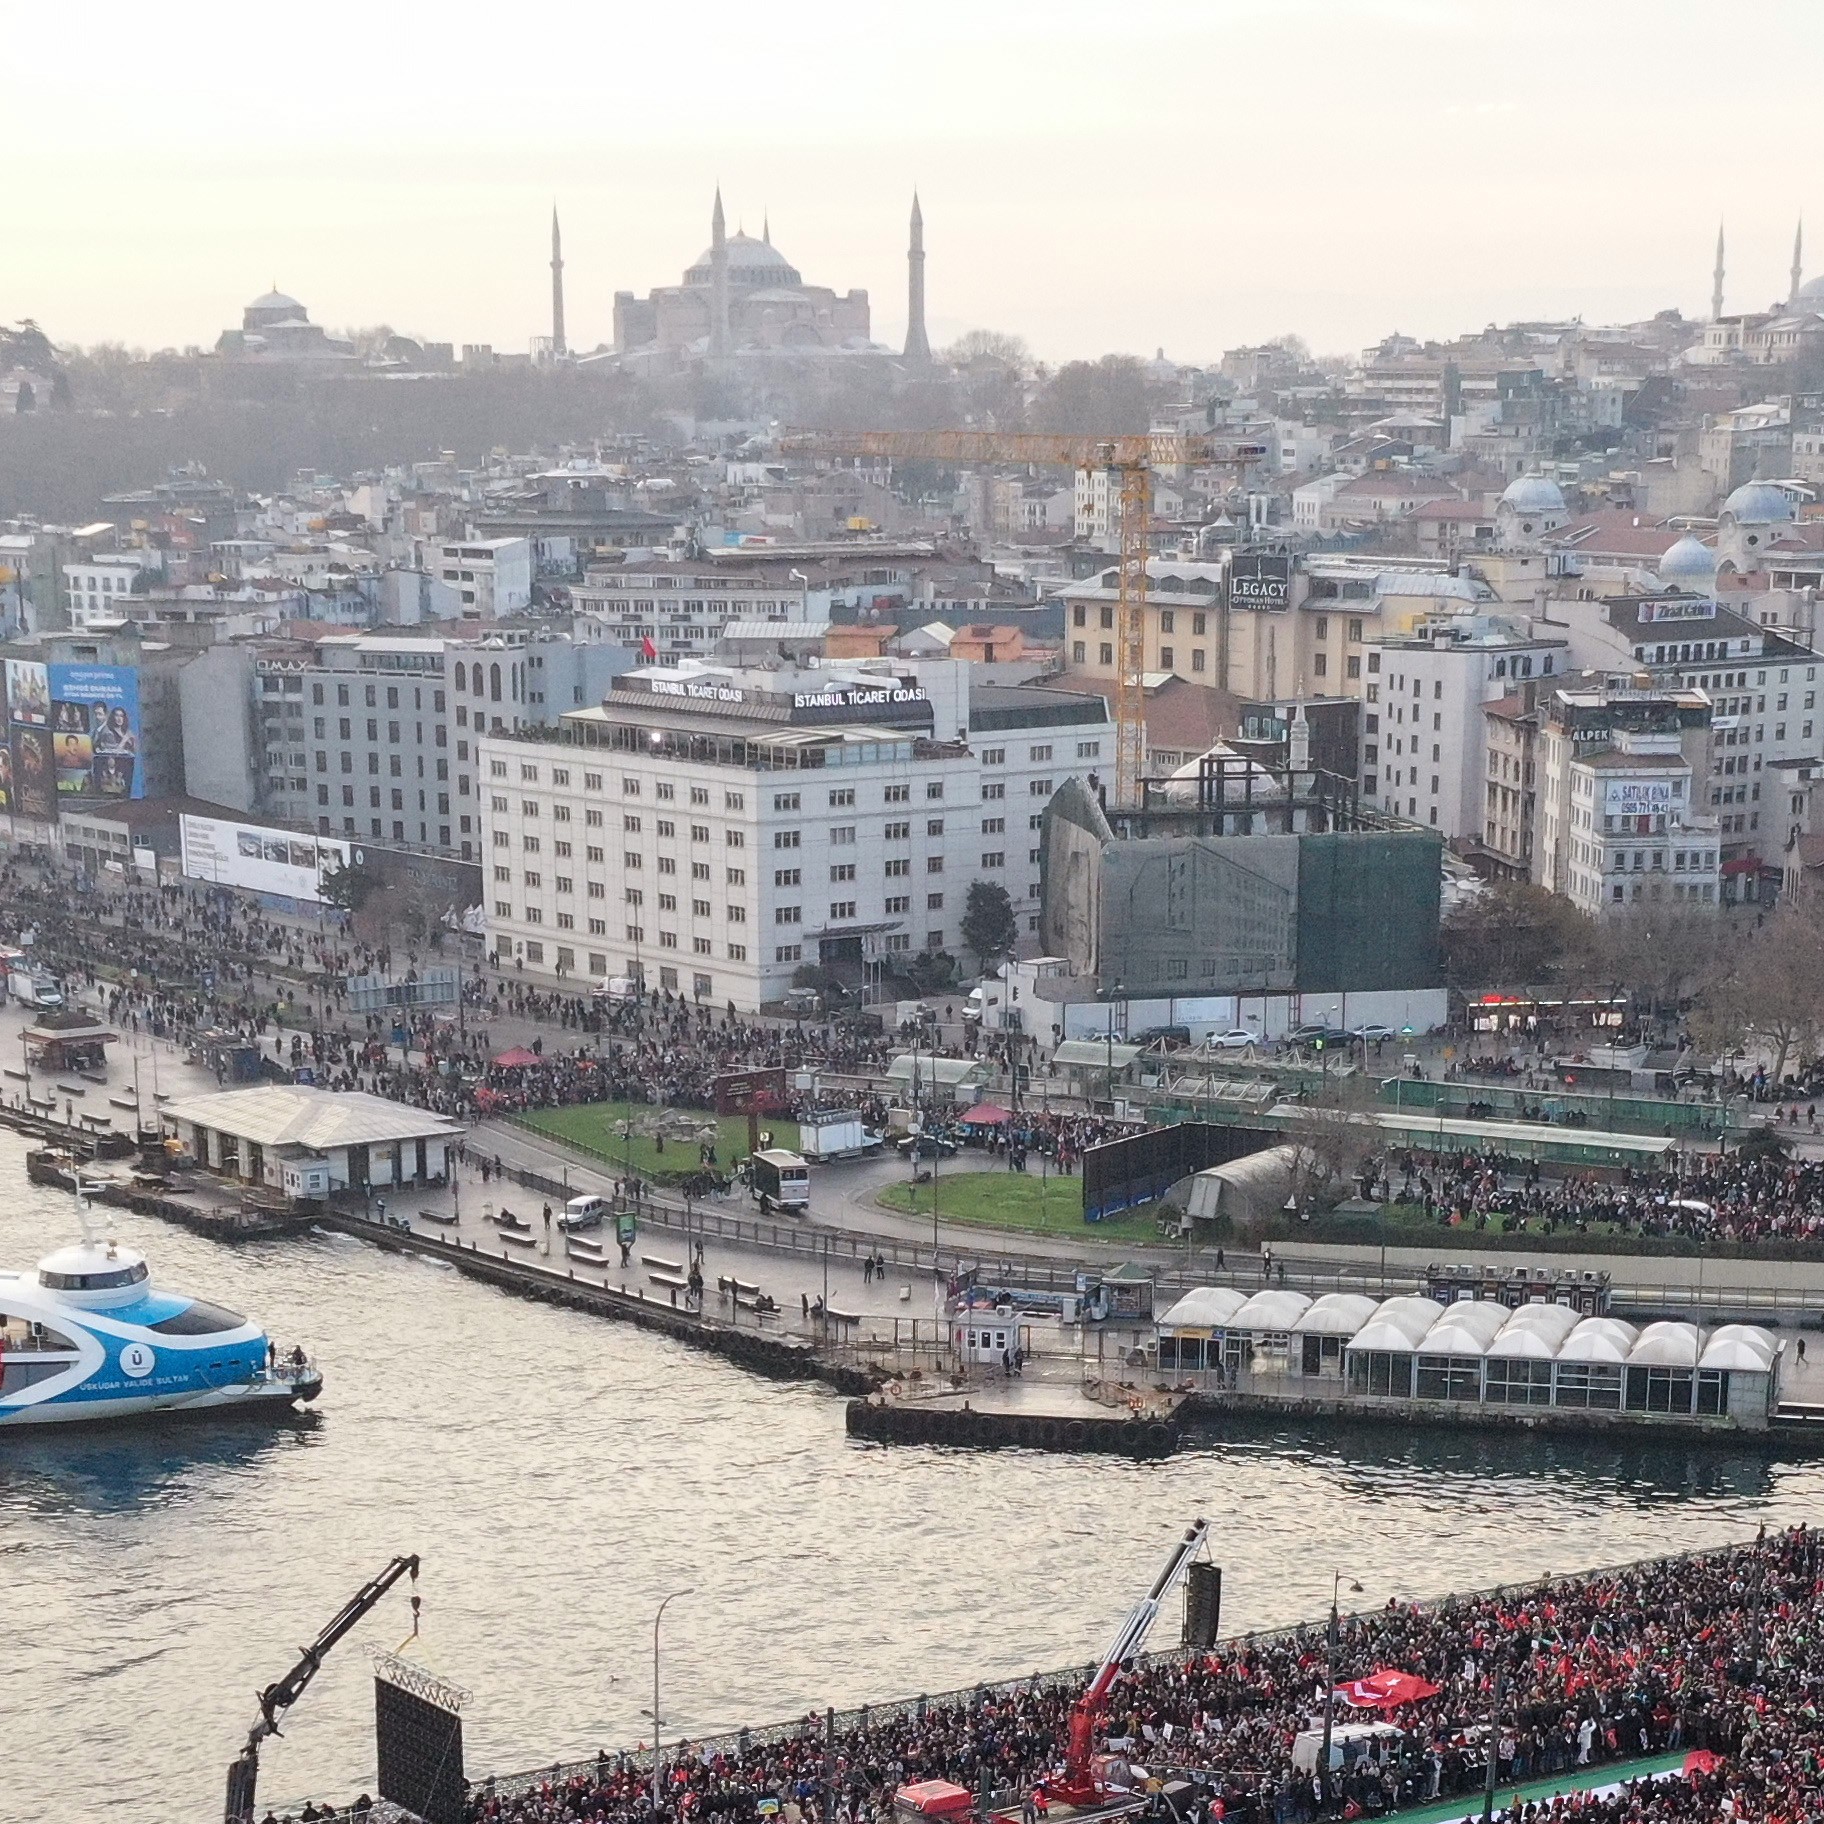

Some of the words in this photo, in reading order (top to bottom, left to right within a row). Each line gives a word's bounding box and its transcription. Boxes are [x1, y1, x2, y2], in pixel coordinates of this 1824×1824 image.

[1232, 579, 1287, 597] LEGACY
[1264, 597, 1284, 605] HOTEL
[256, 660, 308, 671] OMAX
[651, 678, 687, 697] İSTANBUL
[686, 681, 719, 700] TİCARET
[718, 688, 743, 703] ODASI
[794, 691, 846, 708] İSTANBUL
[846, 688, 891, 705] TİCARET
[893, 688, 927, 702] ODASI
[1572, 729, 1609, 741] ALPEK
